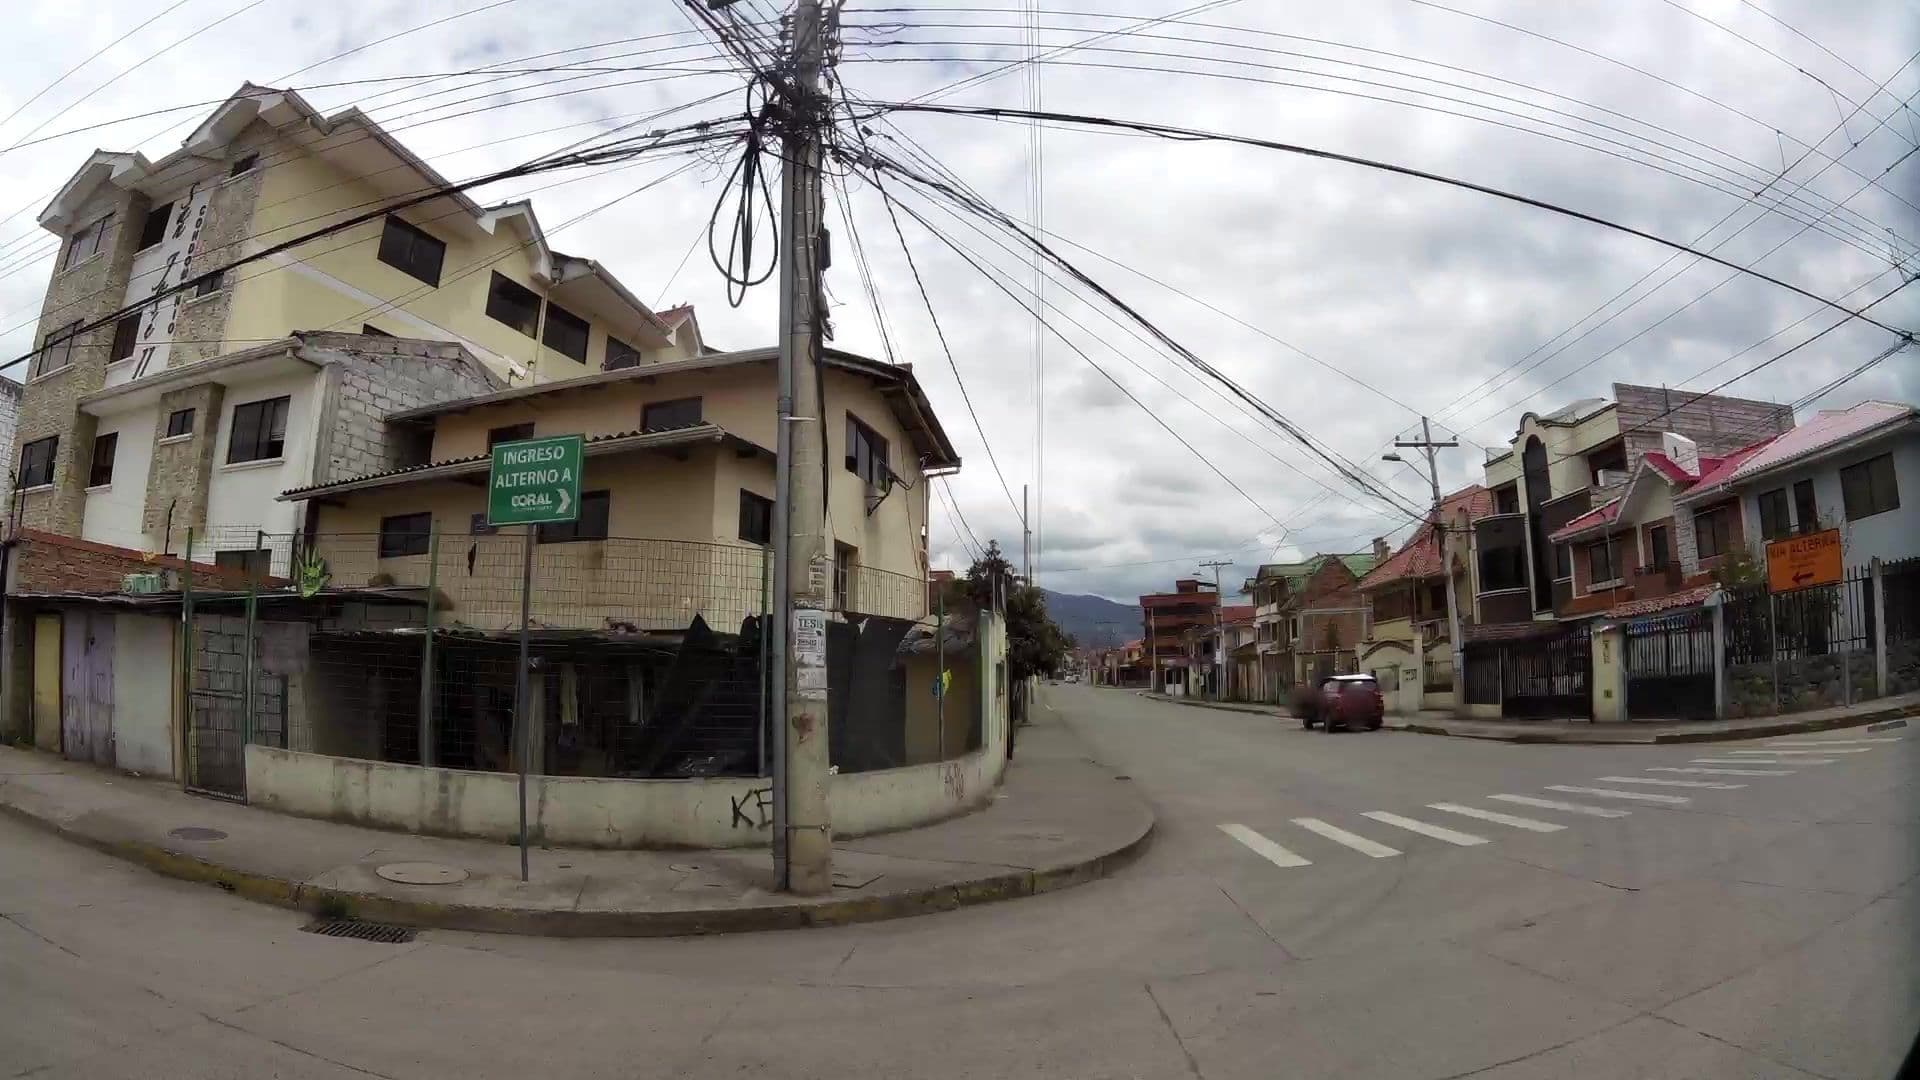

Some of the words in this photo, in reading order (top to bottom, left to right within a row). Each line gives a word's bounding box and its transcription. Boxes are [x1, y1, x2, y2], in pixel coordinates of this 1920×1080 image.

[503, 445, 566, 465] INGRESO
[495, 468, 559, 489] ALTERNO
[561, 466, 573, 483] A
